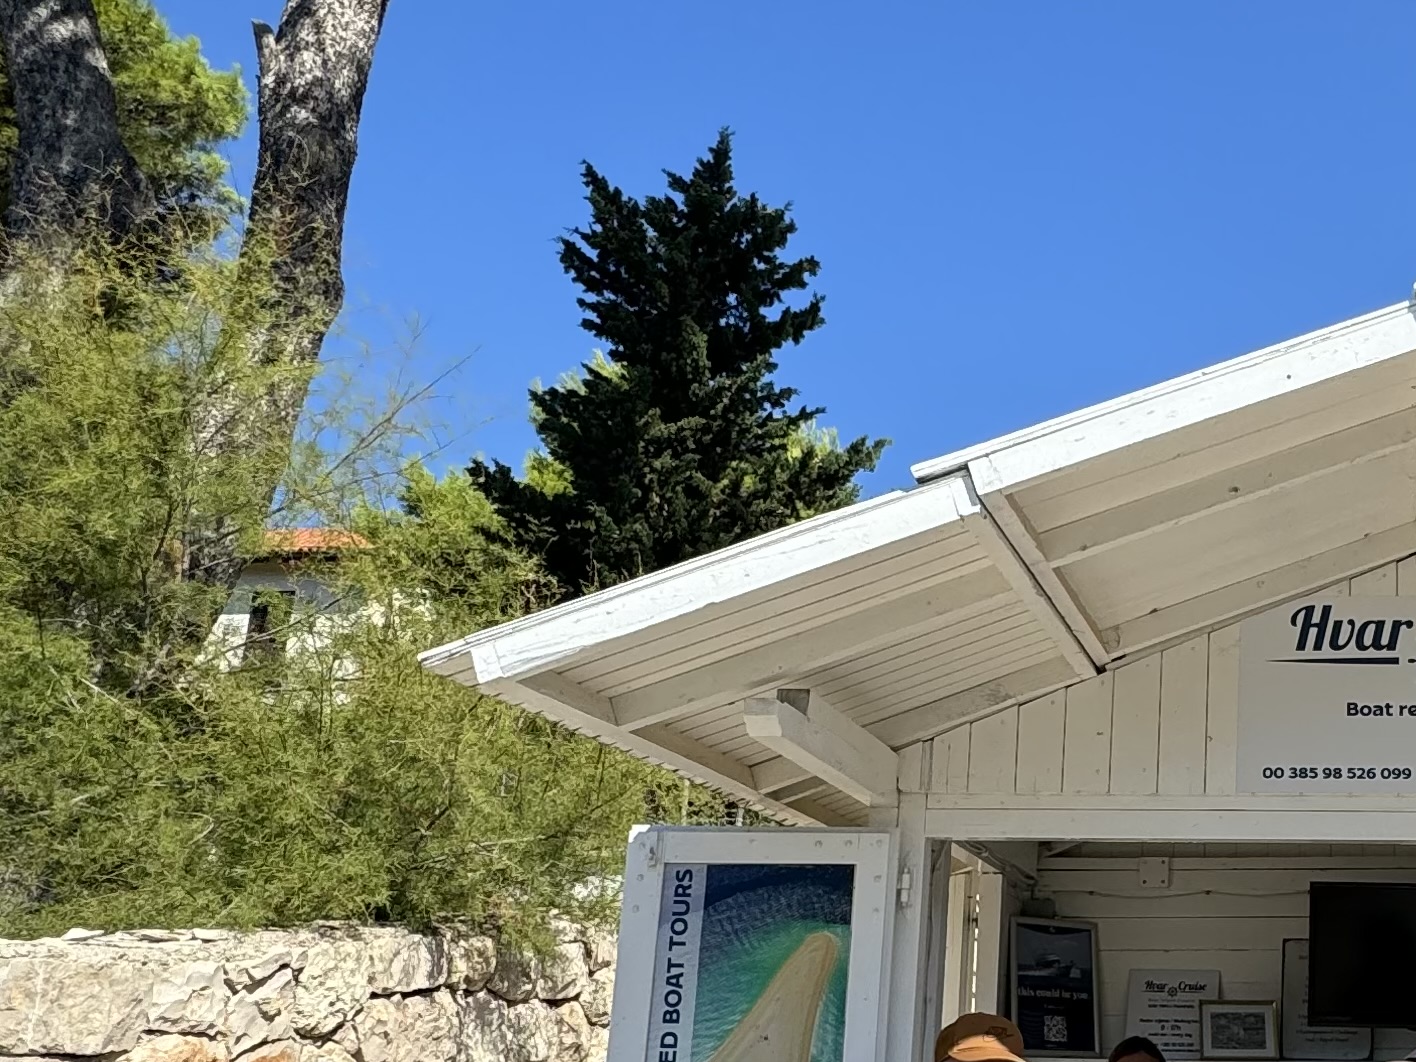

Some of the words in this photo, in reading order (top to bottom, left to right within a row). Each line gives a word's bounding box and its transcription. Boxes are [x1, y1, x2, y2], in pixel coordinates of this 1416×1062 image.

[1290, 603, 1414, 652] Hvar
[1346, 701, 1393, 717] Boat
[1262, 766, 1285, 780] 00
[1288, 766, 1318, 780] 385
[1322, 766, 1343, 780] 98
[1347, 766, 1377, 780] 526
[1380, 766, 1412, 780] 099
[668, 868, 694, 953] TOURS
[662, 955, 686, 1025] BOAT
[1178, 981, 1207, 991] Cruise
